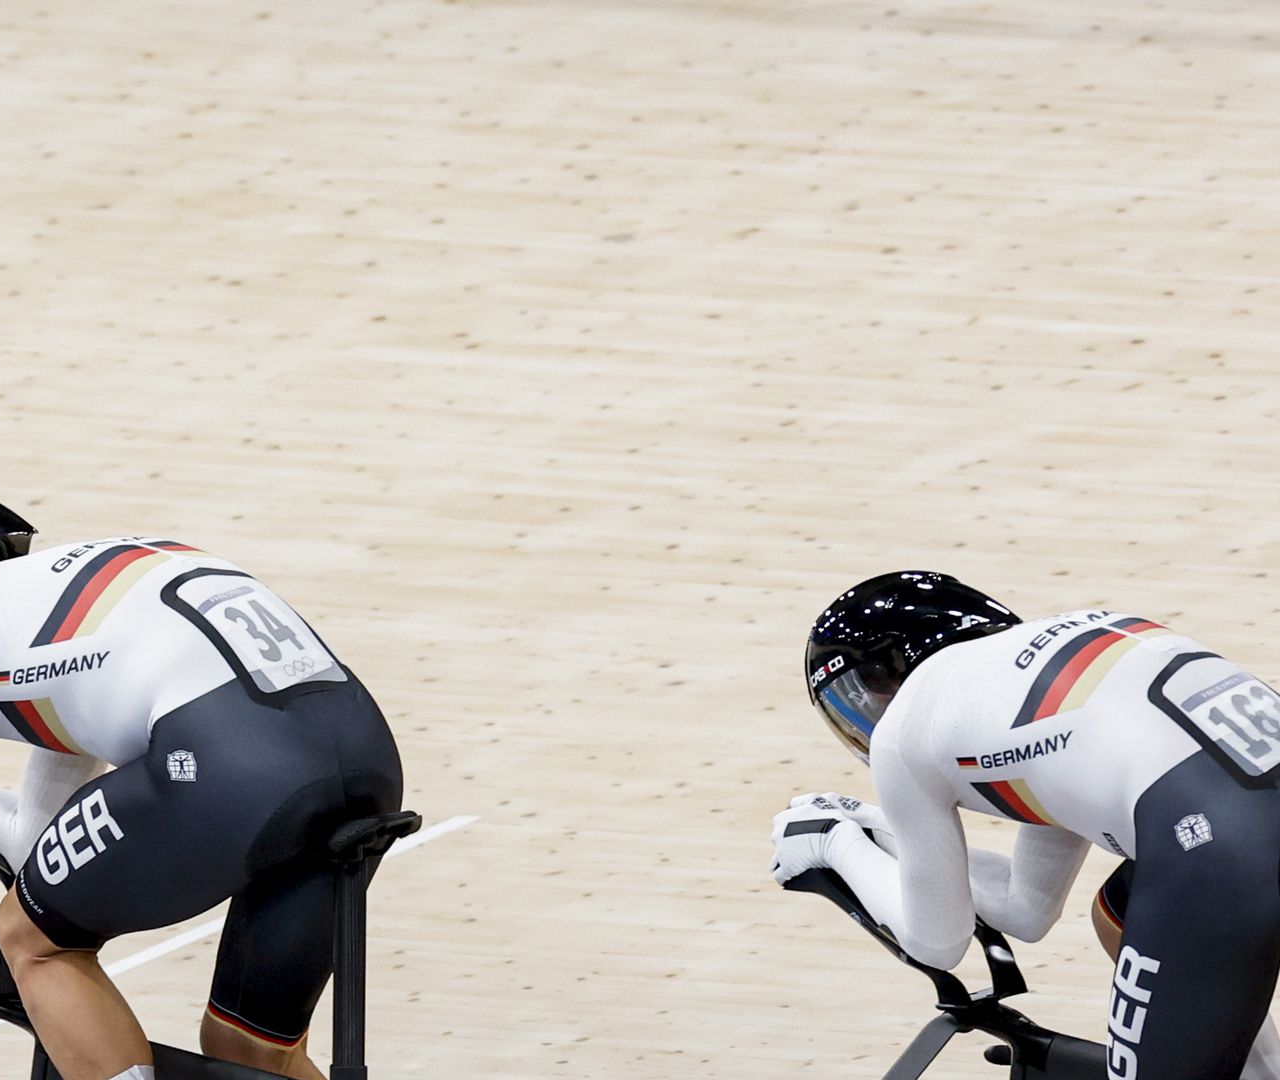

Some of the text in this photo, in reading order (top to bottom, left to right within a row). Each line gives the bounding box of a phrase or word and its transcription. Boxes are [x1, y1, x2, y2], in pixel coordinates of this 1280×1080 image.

[224, 599, 305, 663] 34
[13, 651, 111, 685] GERMANY
[980, 730, 1073, 769] GERMANY
[36, 788, 125, 886] GER
